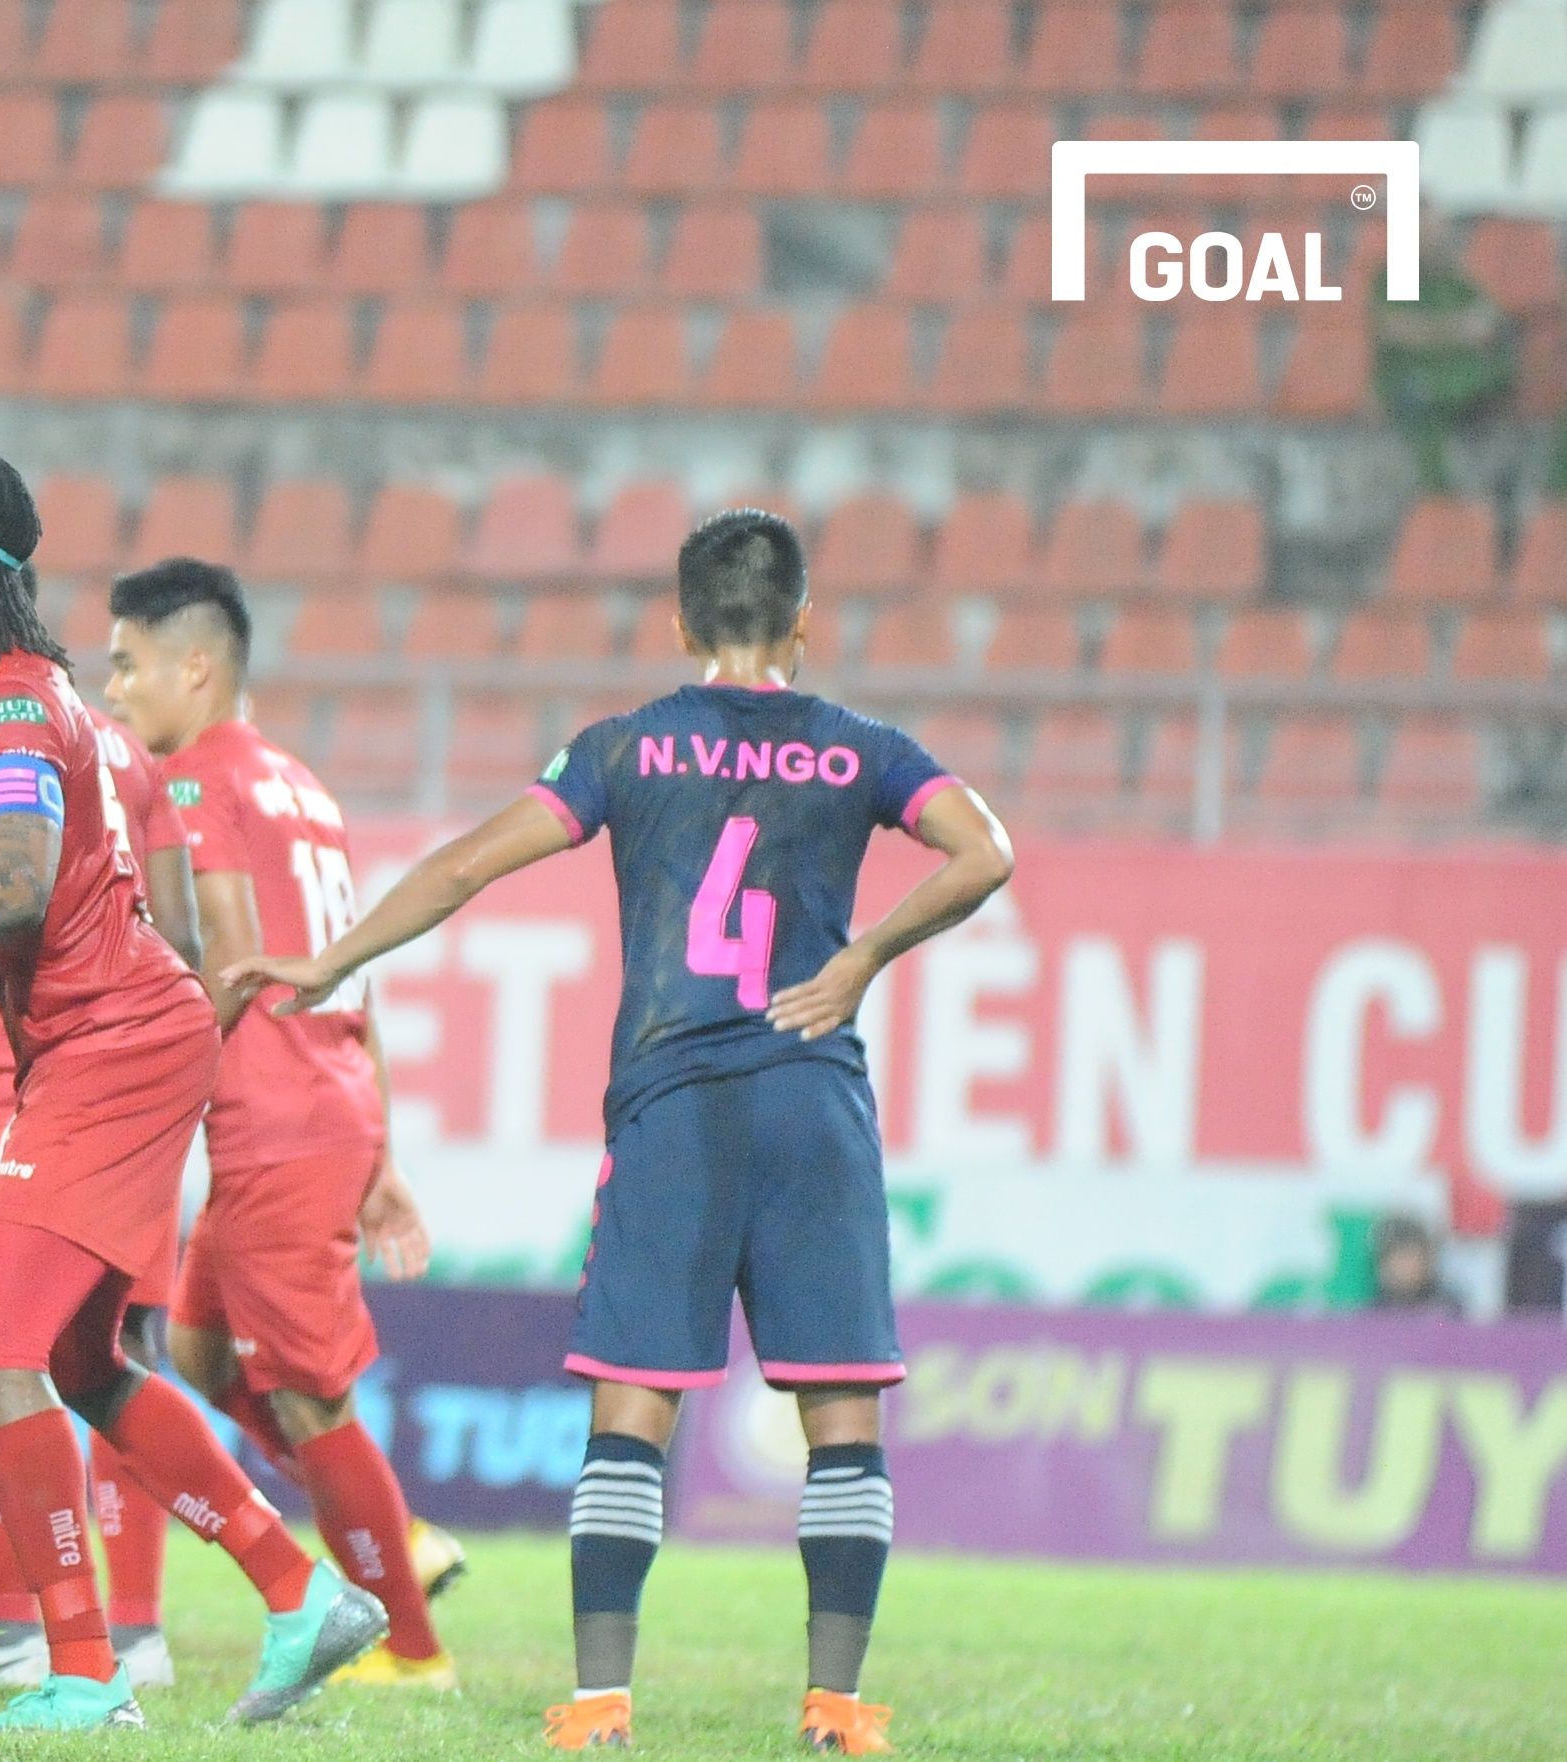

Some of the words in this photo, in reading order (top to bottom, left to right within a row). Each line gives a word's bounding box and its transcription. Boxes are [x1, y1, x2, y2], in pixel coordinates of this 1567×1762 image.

[639, 735, 860, 787] N.V.NGO
[686, 816, 777, 1010] 4
[49, 1508, 81, 1568] mitre
[172, 1491, 227, 1535] mitre
